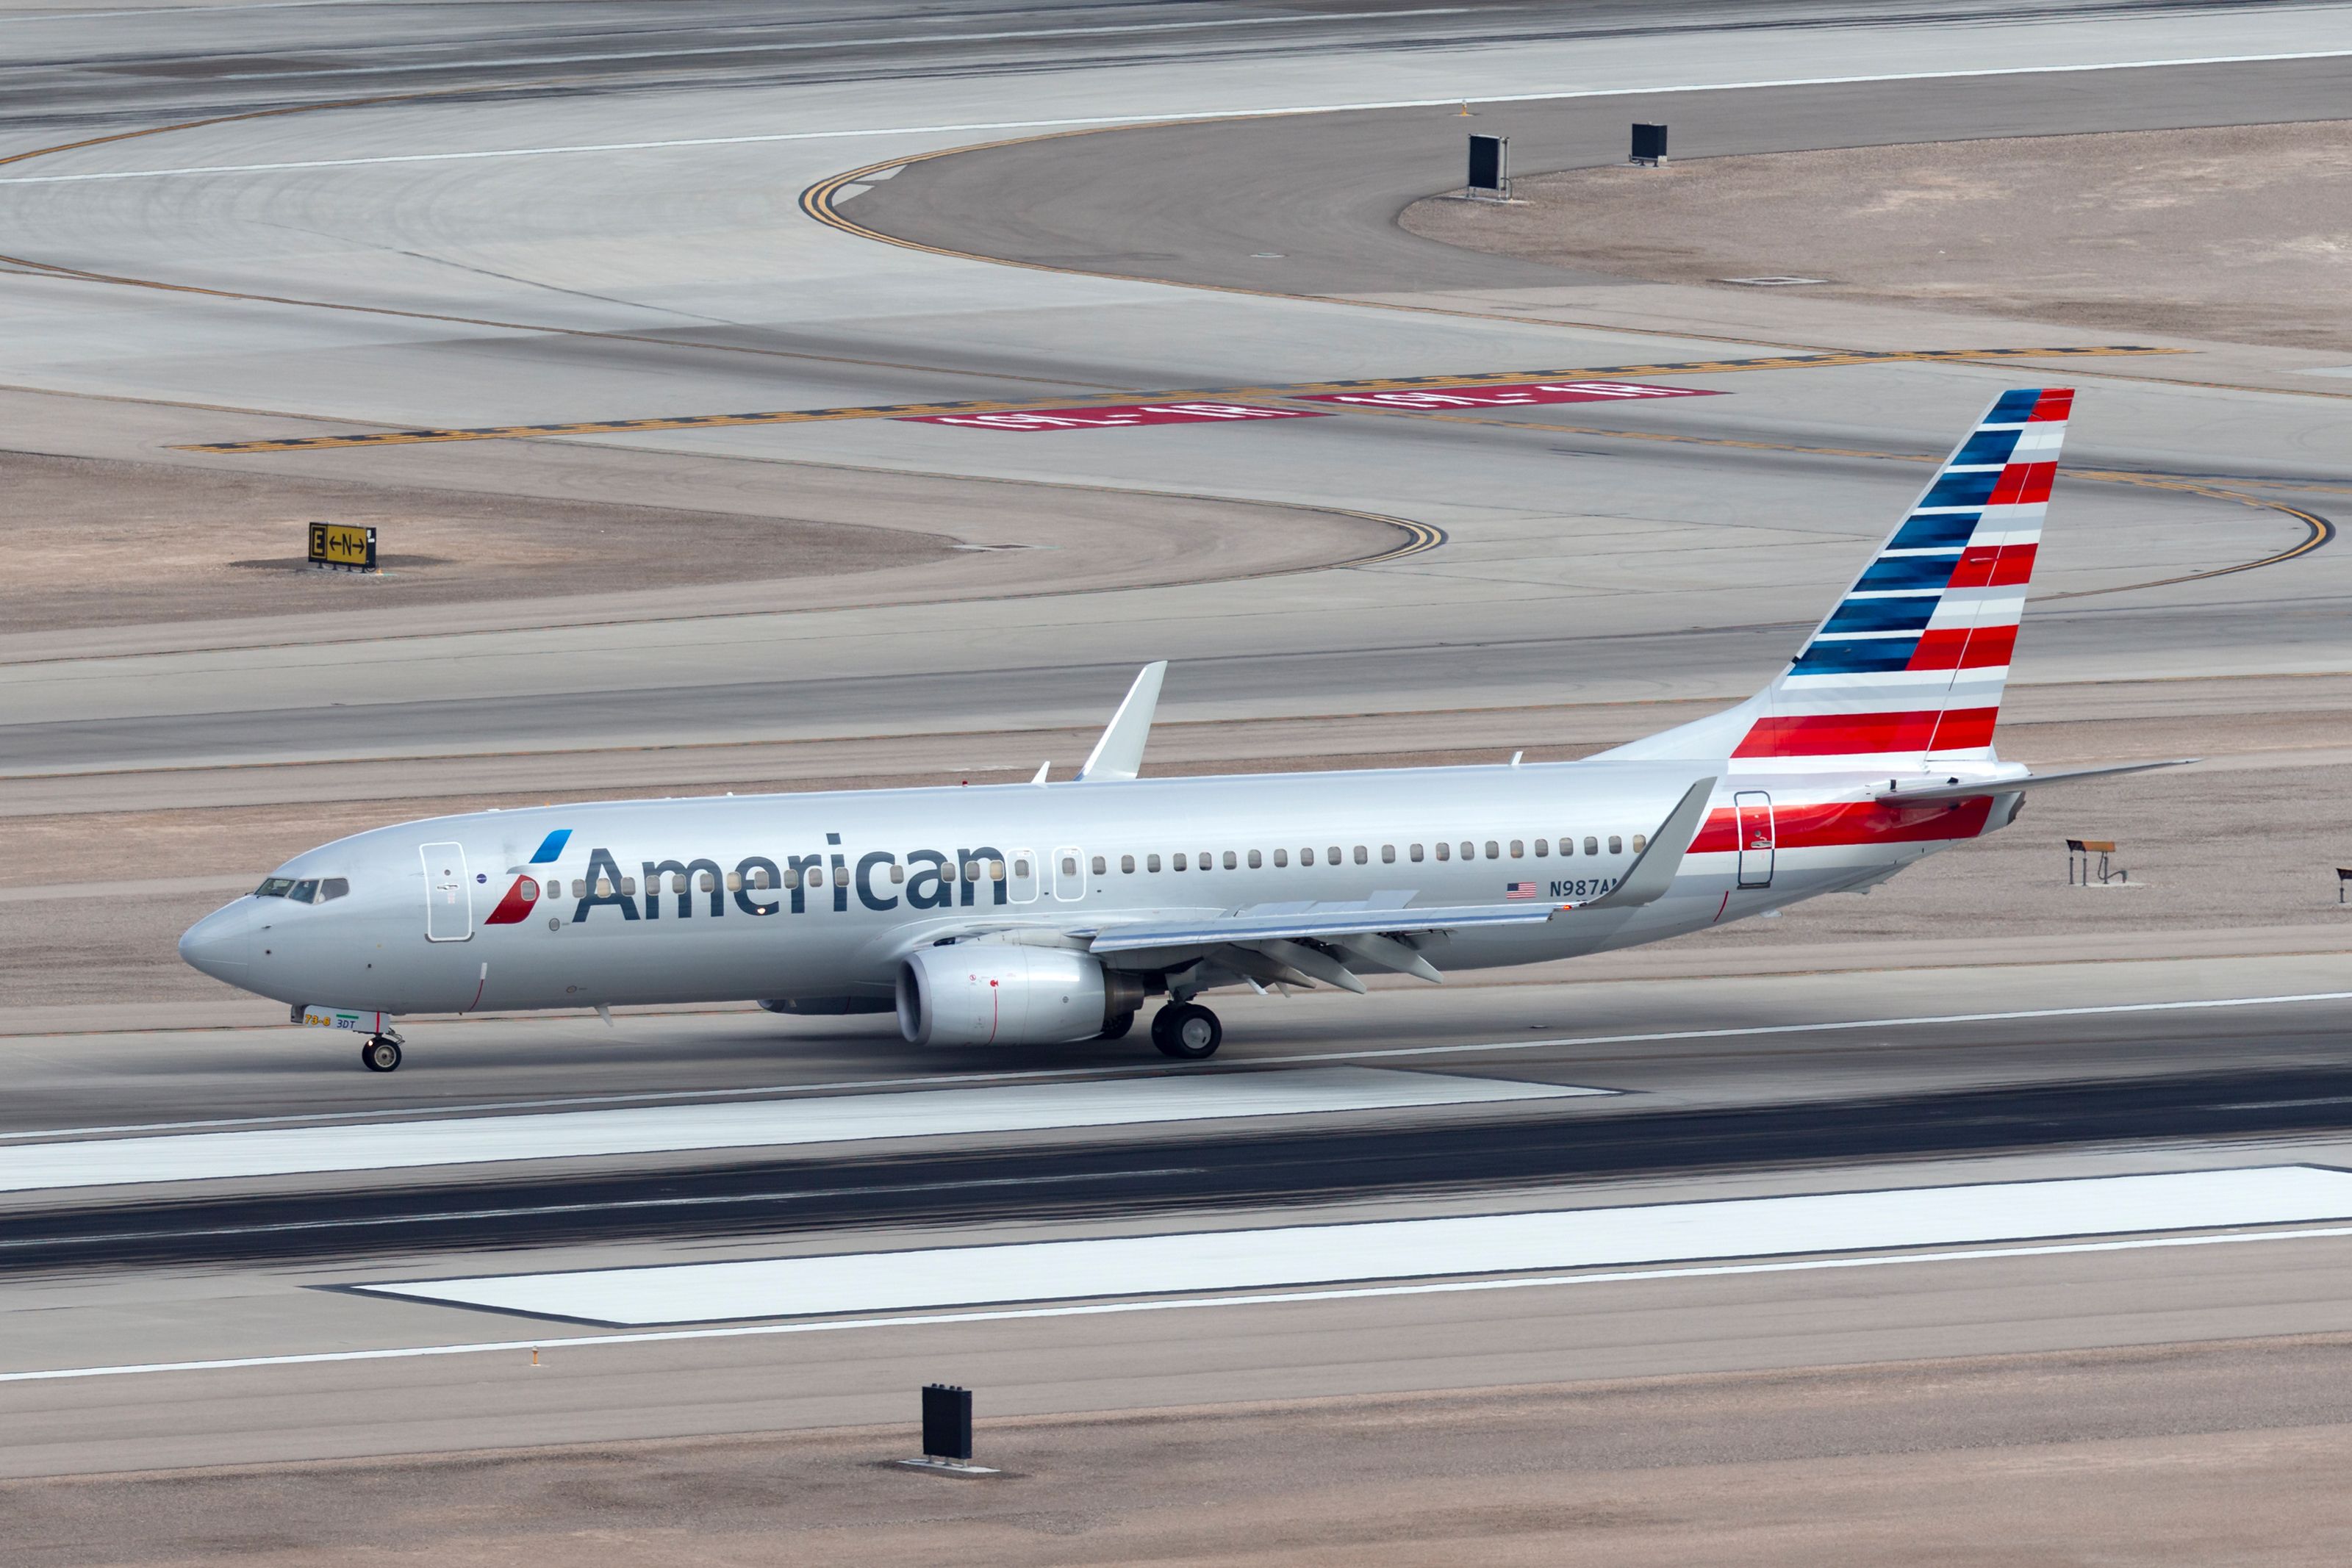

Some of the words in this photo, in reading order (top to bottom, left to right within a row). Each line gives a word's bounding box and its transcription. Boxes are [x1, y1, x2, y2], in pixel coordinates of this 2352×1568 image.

[314, 530, 323, 553] E
[343, 533, 352, 556] N
[572, 832, 1008, 923] American
[1550, 878, 1618, 897] N987A
[305, 1014, 331, 1026] 73-8
[337, 1019, 356, 1029] 3DT
